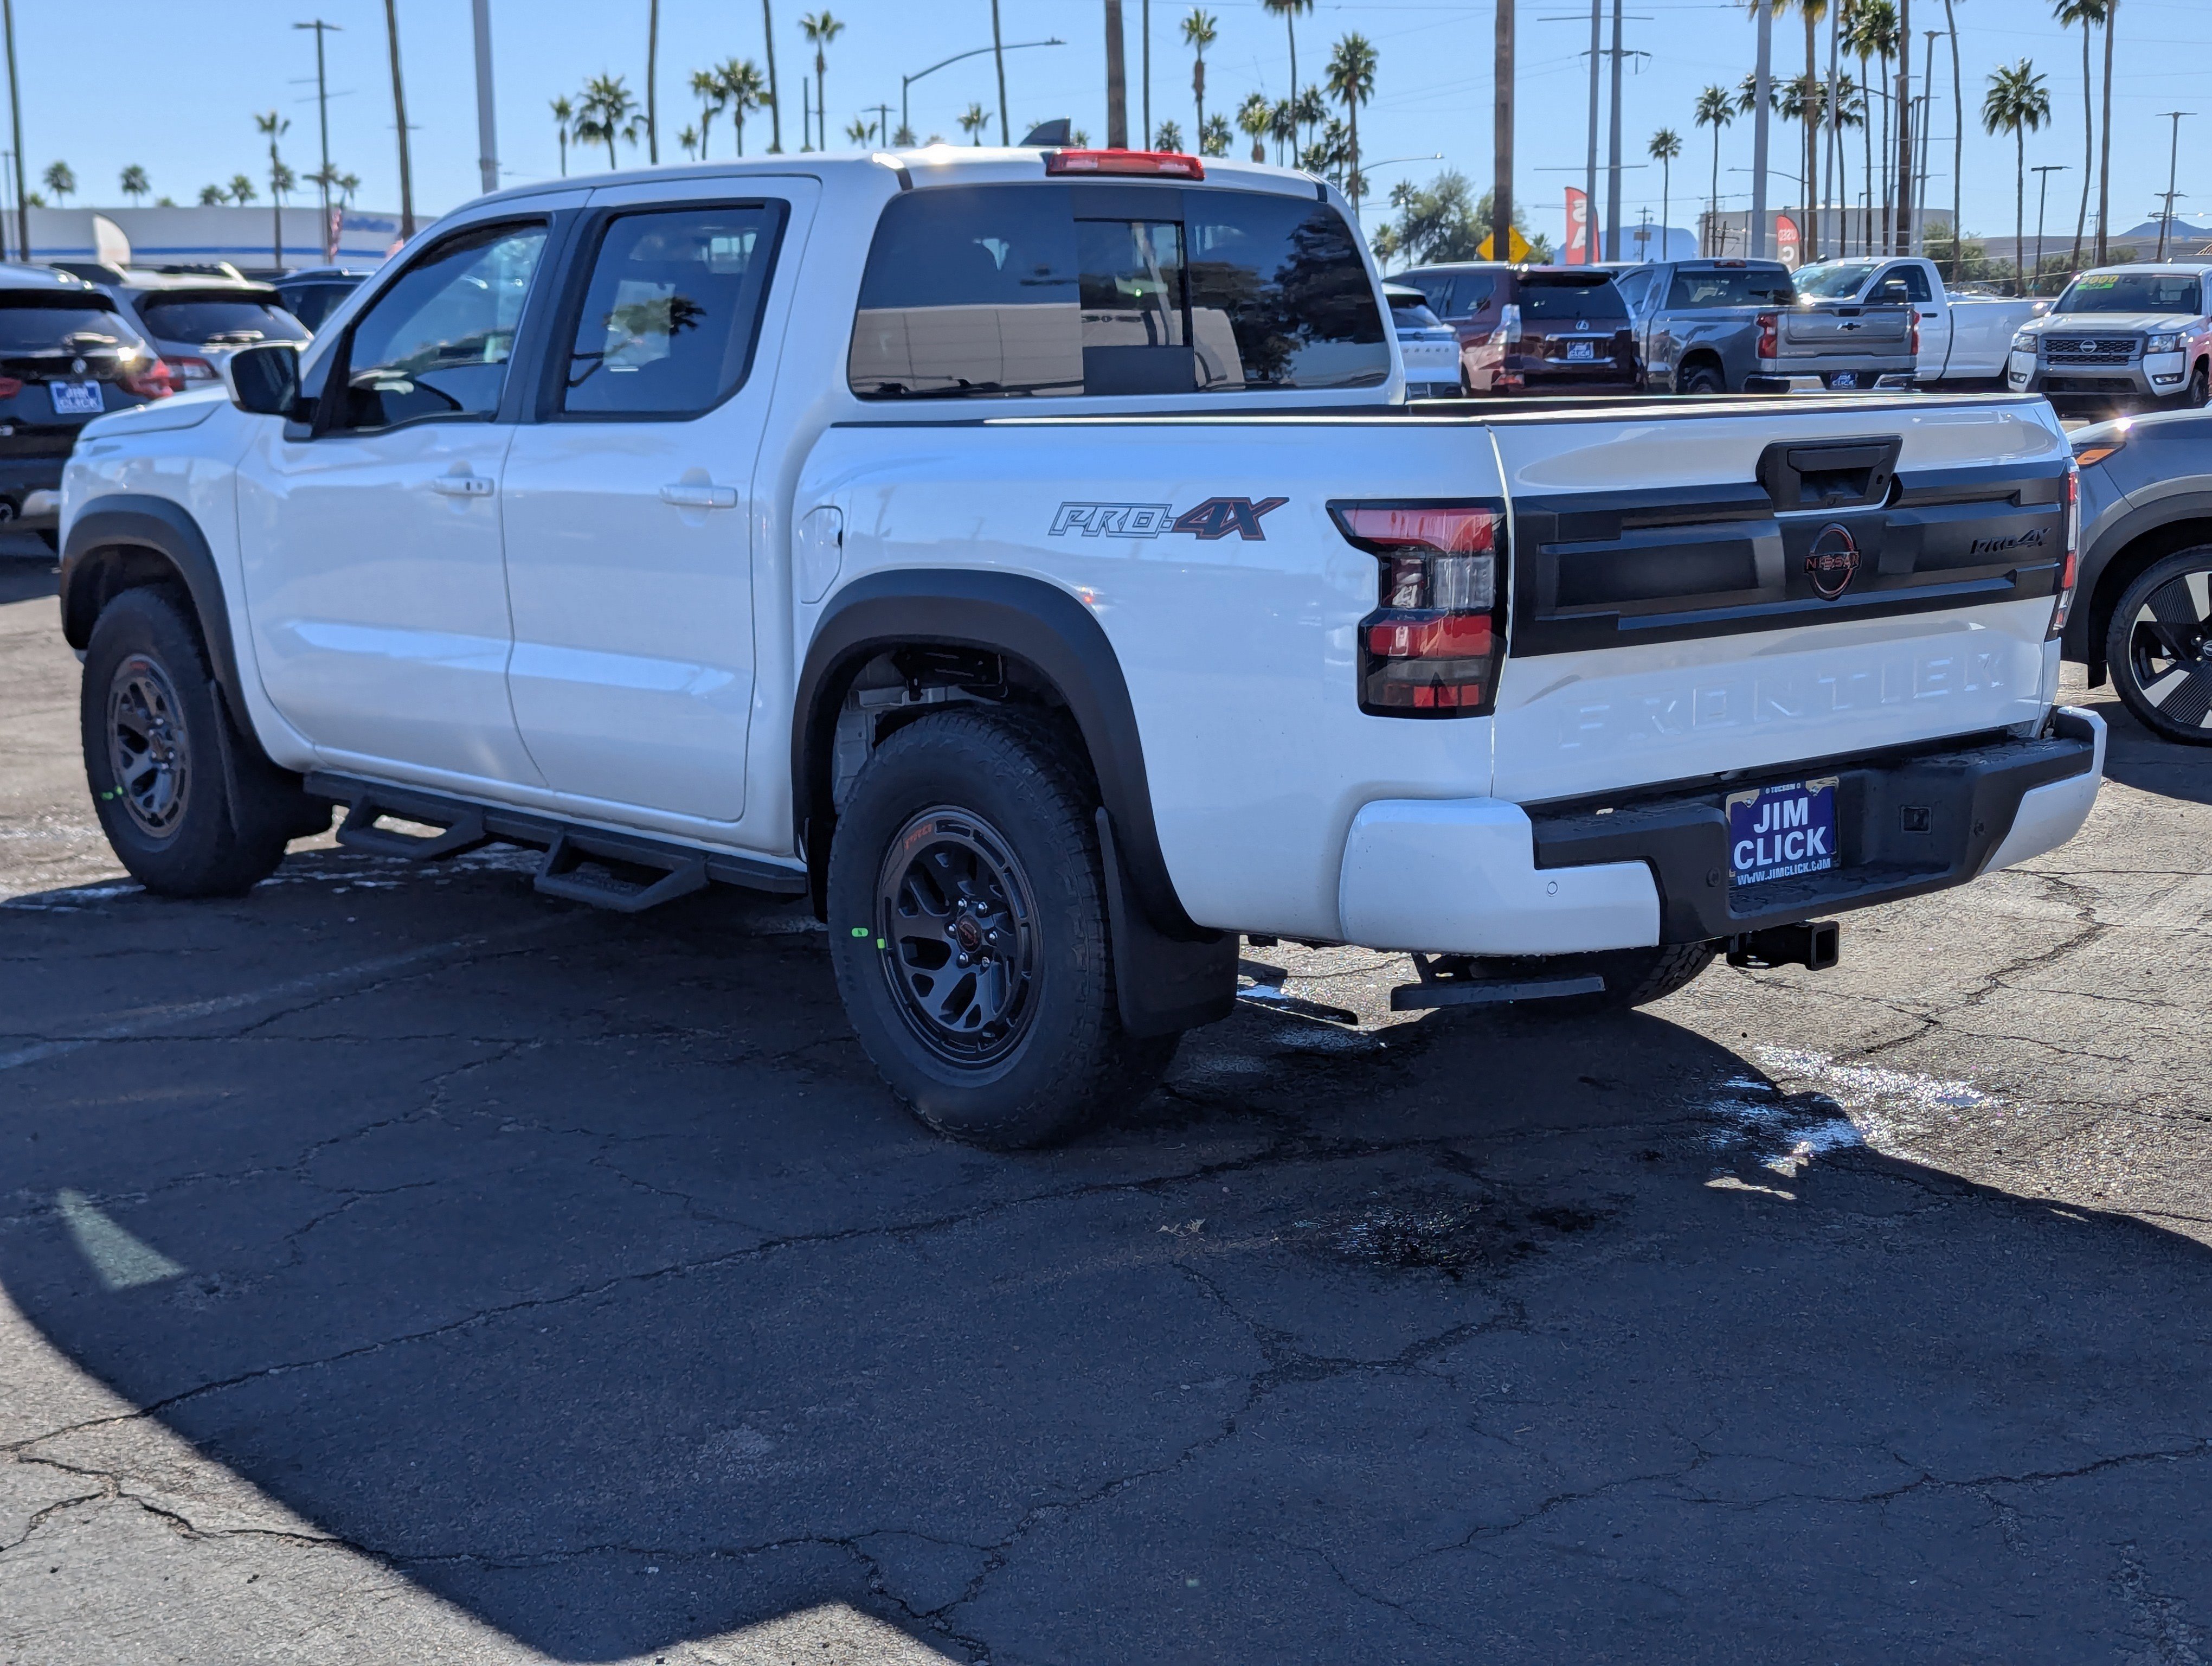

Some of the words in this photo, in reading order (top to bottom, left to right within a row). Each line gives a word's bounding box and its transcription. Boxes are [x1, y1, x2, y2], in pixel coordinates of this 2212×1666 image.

[1806, 552, 1860, 571] NISSAN
[1558, 652, 2005, 749] FRONTIER
[1753, 797, 1808, 834] JIM
[1733, 826, 1827, 870] CLICK
[1737, 858, 1831, 886] WWW.JIMCLICK.COM
